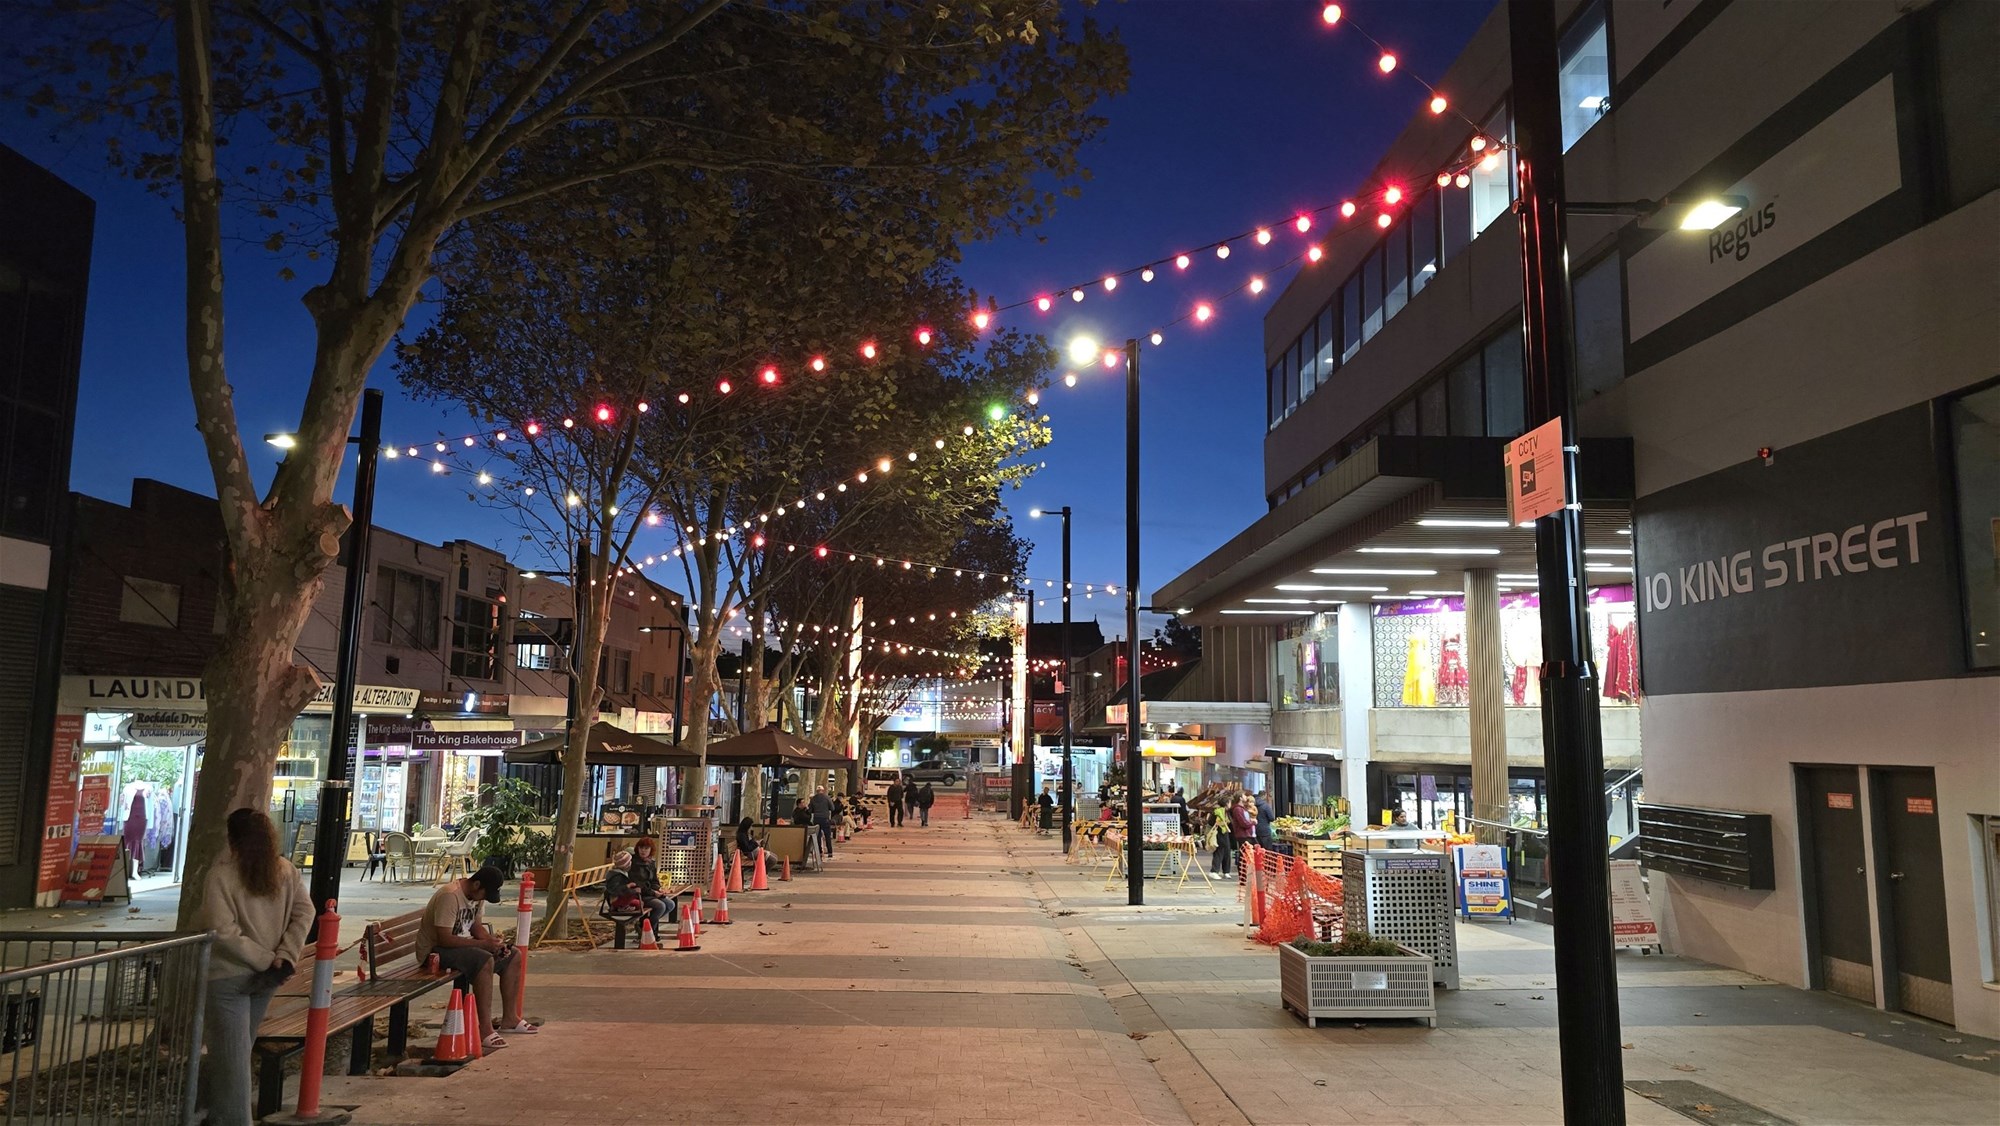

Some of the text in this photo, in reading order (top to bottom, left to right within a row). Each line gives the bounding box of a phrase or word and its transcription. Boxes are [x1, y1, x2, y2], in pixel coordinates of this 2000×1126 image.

[1708, 202, 1776, 264] Regus
[1518, 434, 1539, 457] CCTV
[1679, 550, 1754, 606] KING
[1762, 511, 1928, 589] STREET
[360, 688, 413, 707] ALTERATIONS
[136, 711, 180, 724] Rockdale
[93, 724, 103, 732] 9A
[368, 723, 419, 735] The King Bakehoue
[416, 735, 518, 746] The King Bakehouse
